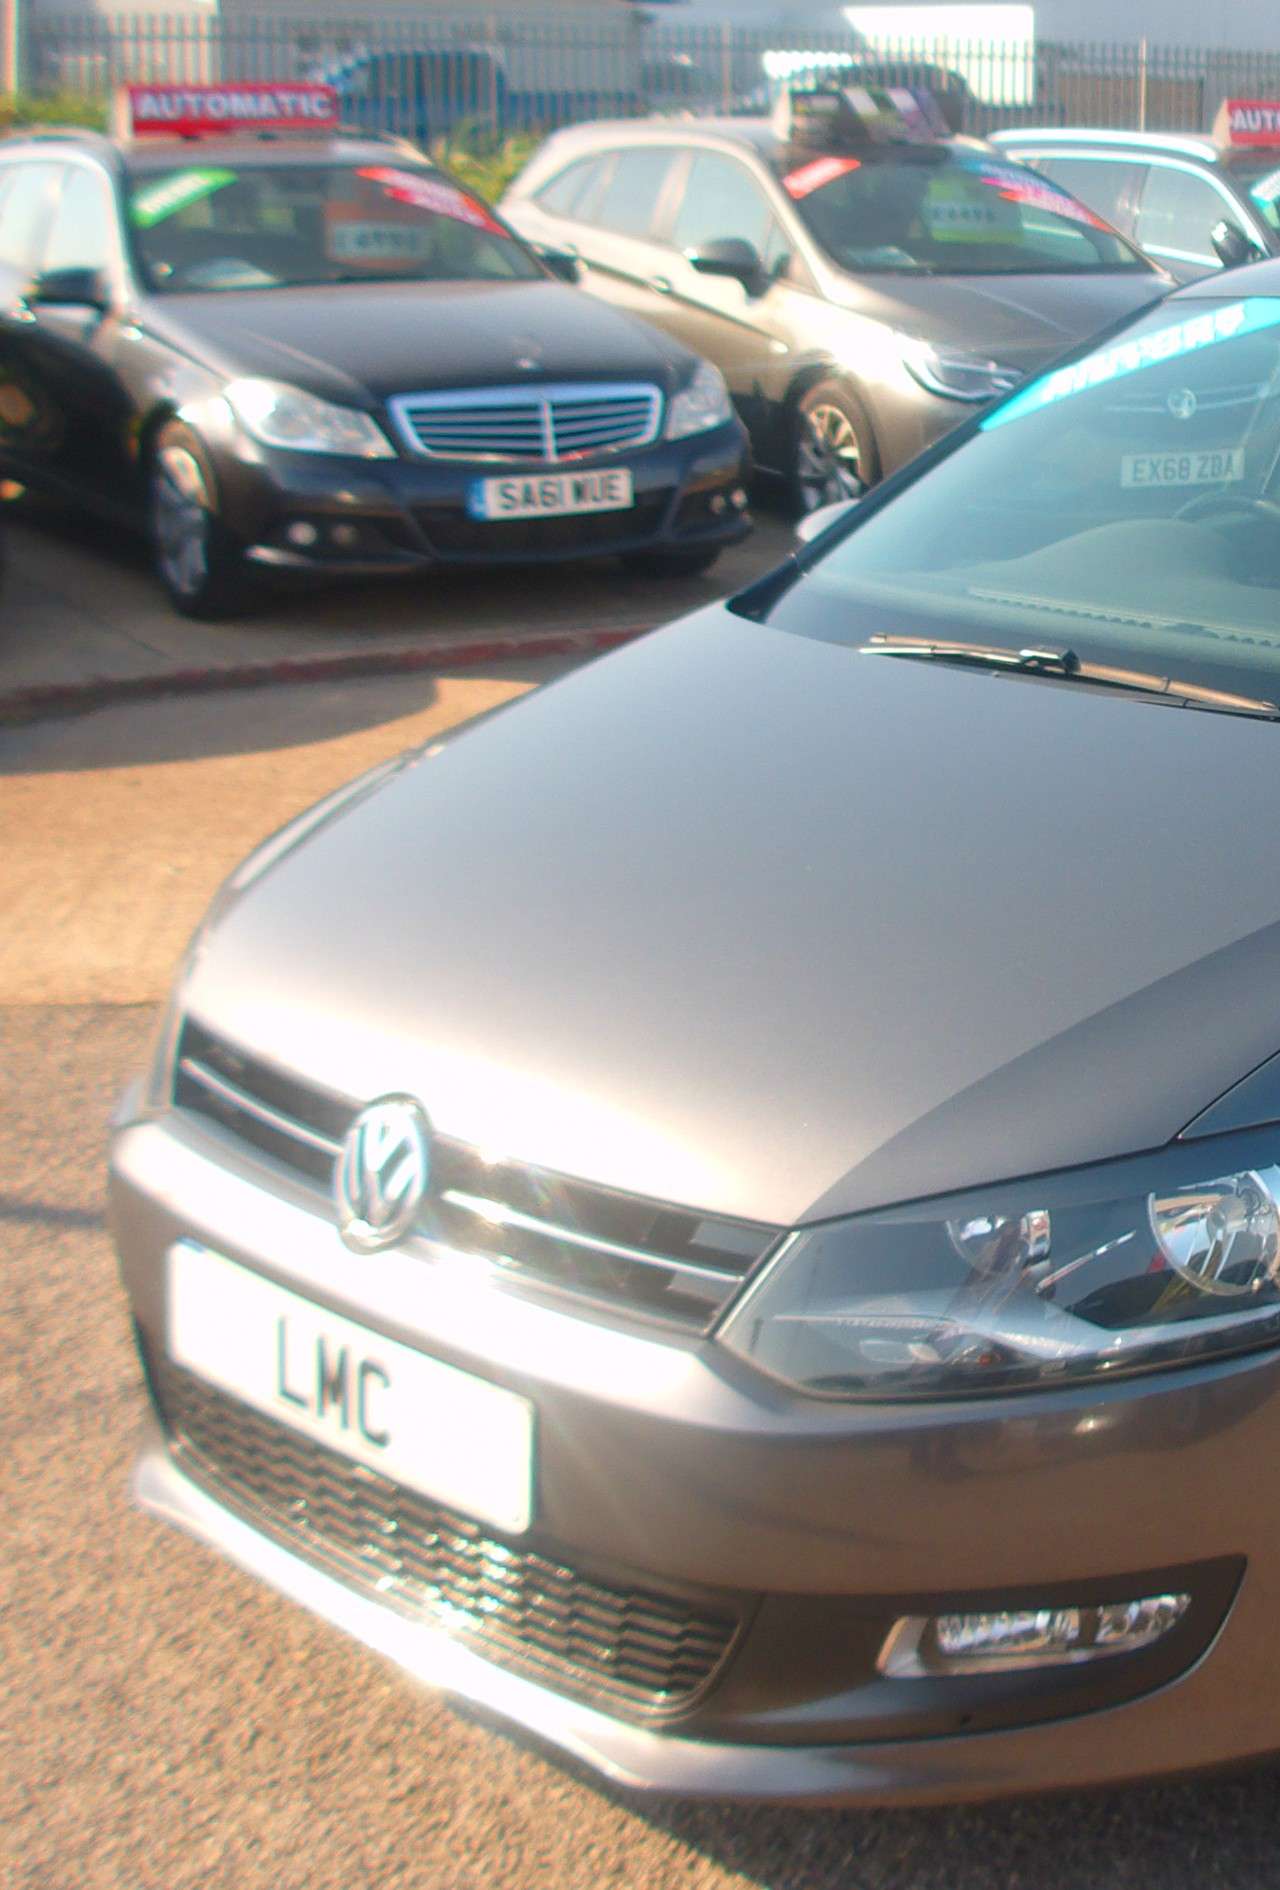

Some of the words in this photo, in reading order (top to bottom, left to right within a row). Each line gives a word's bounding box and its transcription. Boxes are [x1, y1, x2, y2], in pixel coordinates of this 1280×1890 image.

[139, 91, 333, 119] AUTOMATIC
[1132, 455, 1191, 482] EX68
[277, 1315, 391, 1449] LMC
